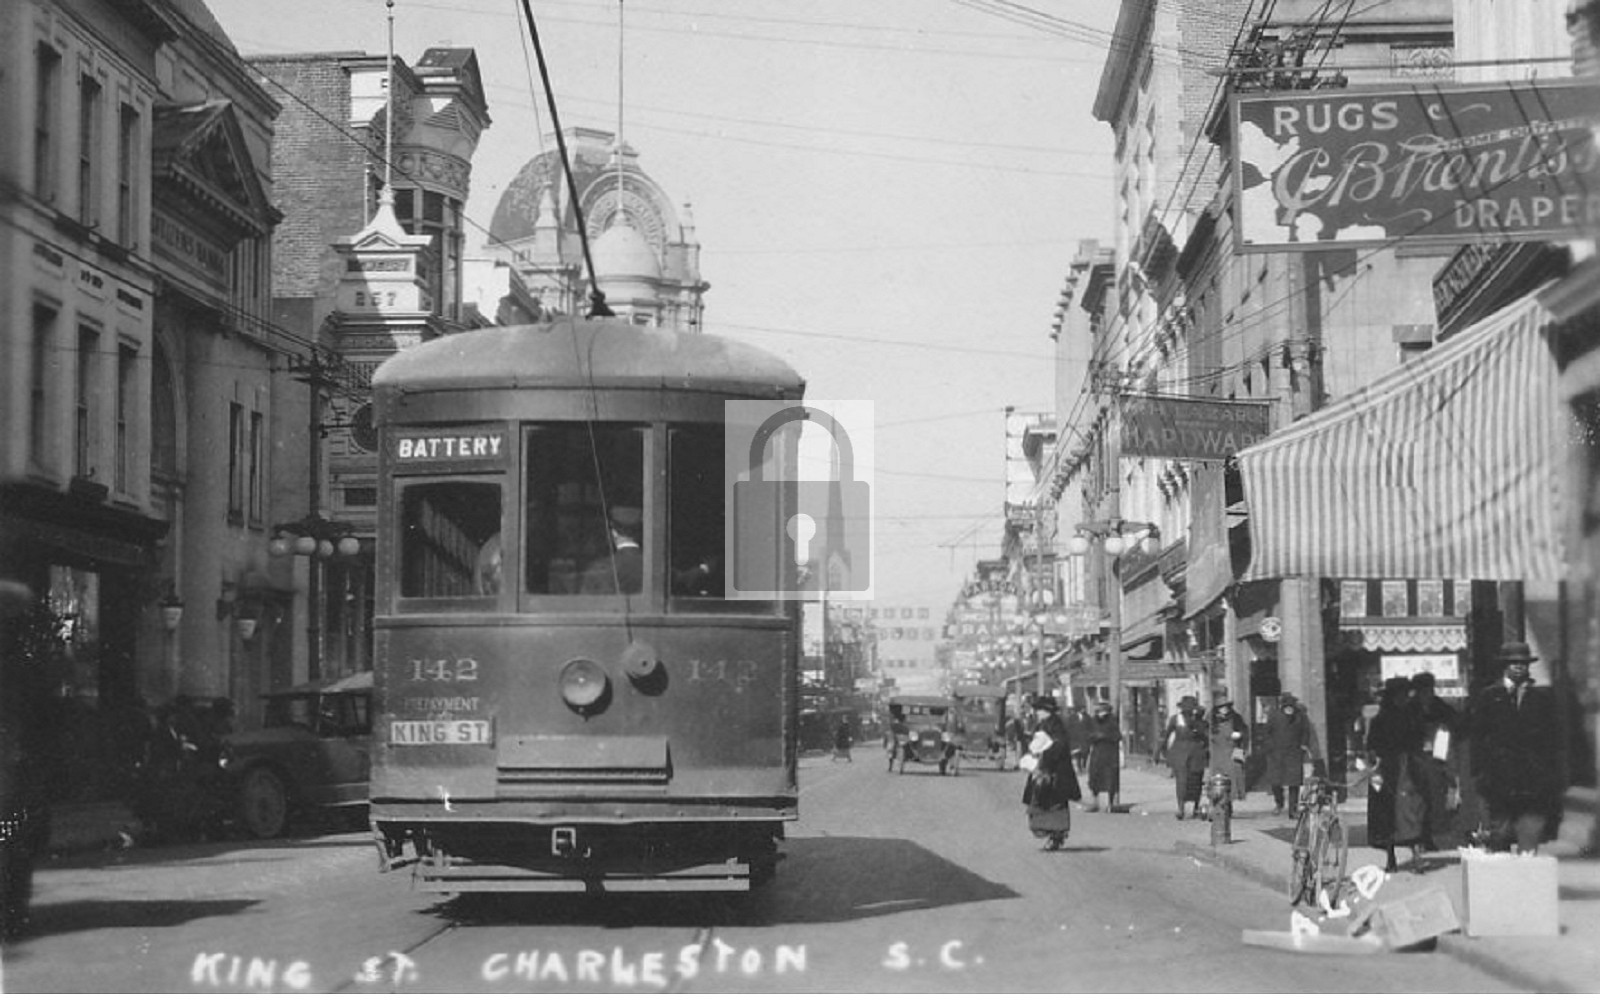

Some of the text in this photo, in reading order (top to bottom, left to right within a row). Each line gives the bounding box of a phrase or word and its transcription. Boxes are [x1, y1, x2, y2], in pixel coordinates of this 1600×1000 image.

[1273, 101, 1399, 136] RUGS
[399, 436, 502, 458] BATTERY
[410, 657, 479, 682] 142
[394, 722, 486, 743] KING ST
